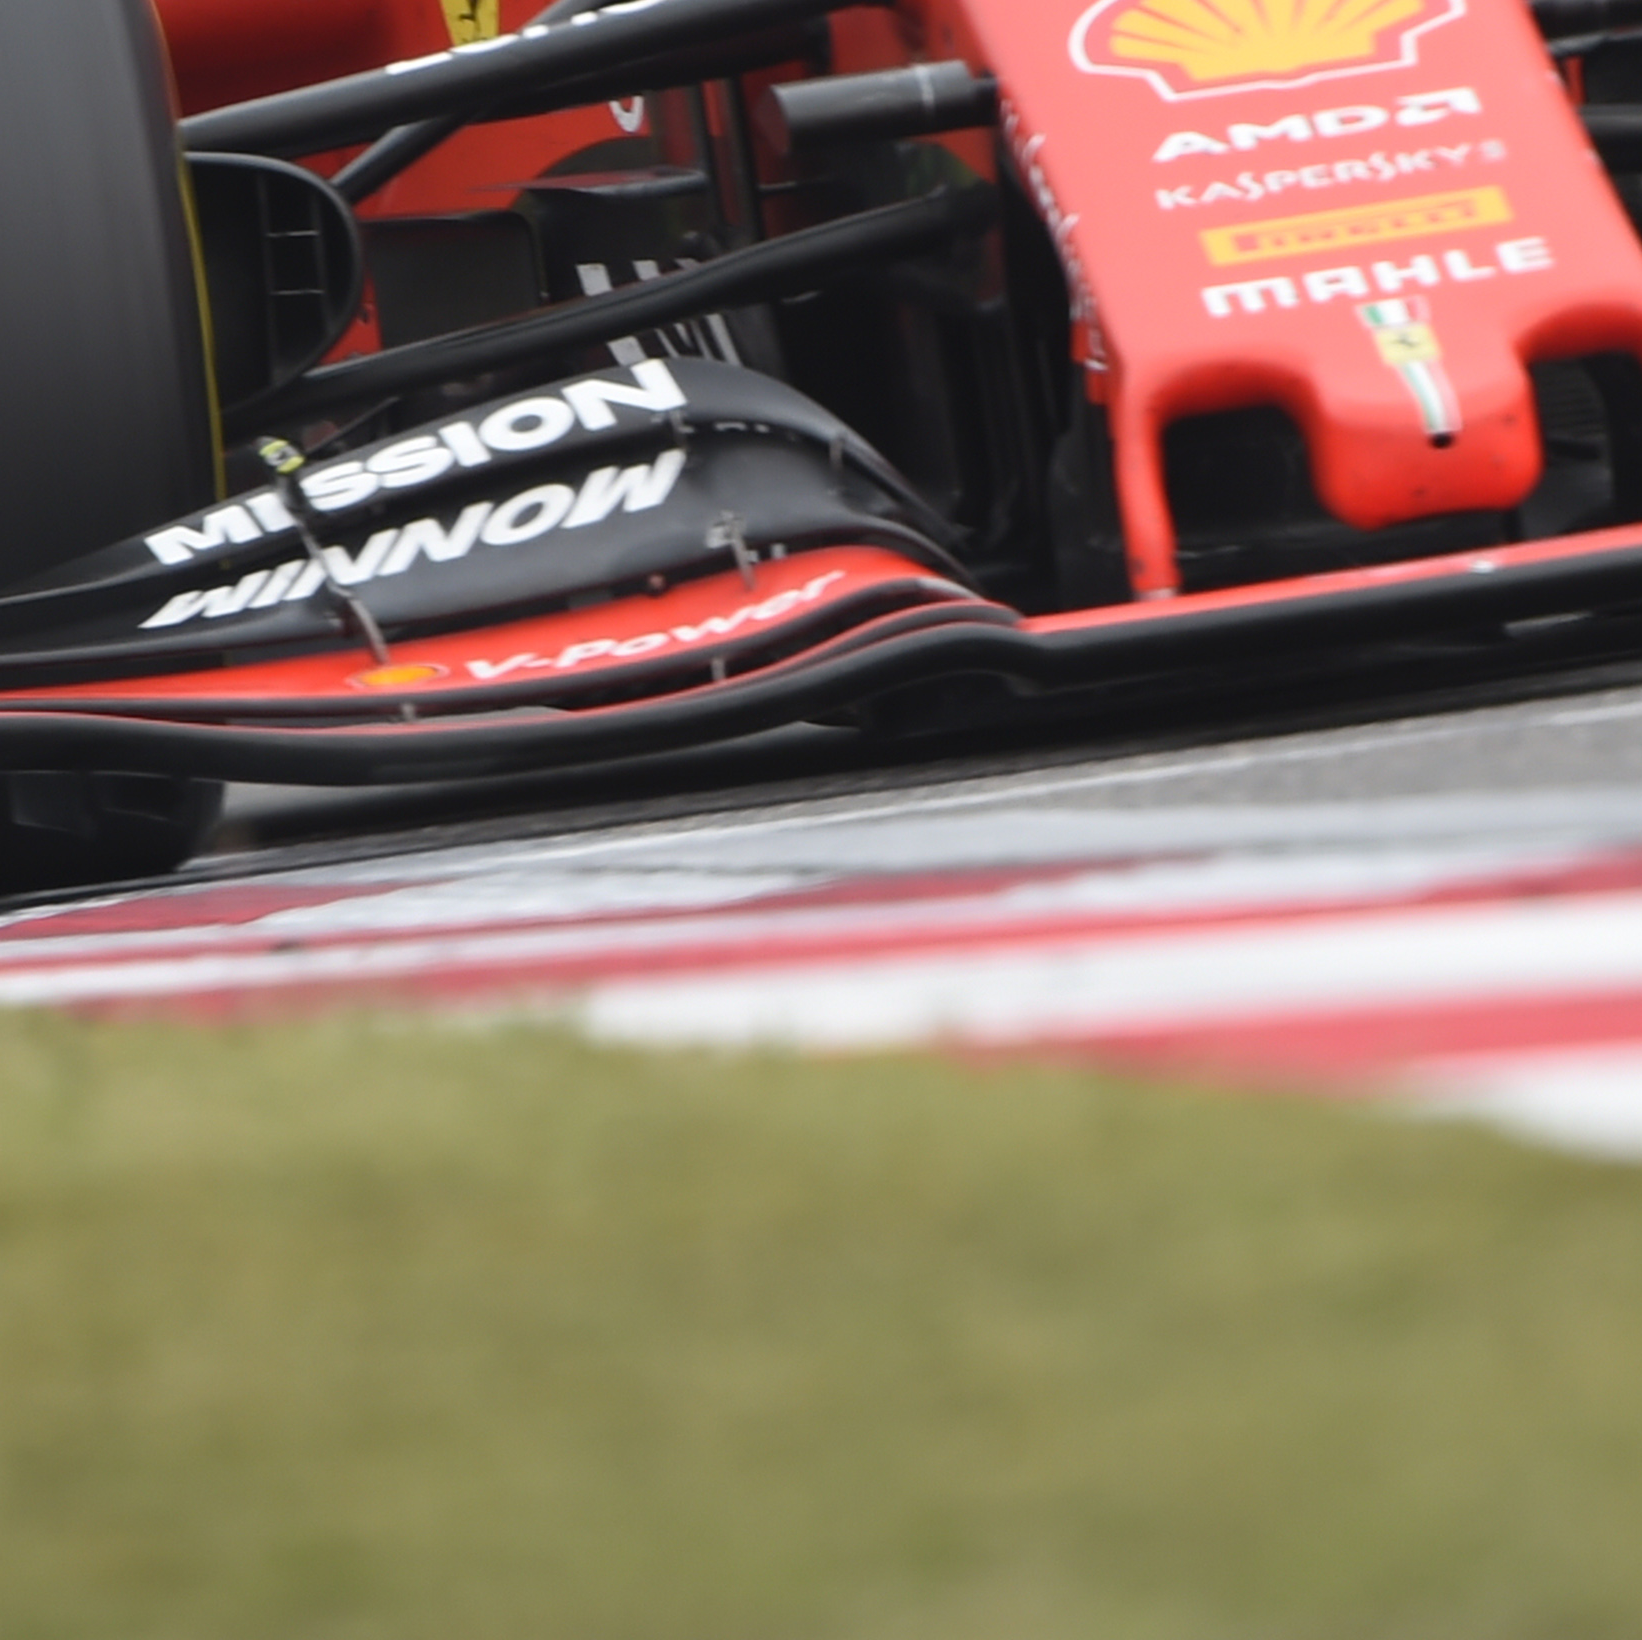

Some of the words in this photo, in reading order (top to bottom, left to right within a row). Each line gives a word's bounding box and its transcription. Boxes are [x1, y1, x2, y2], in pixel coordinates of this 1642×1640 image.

[1153, 105, 1390, 163] AMD
[1154, 143, 1472, 210] KASPERSKY
[1200, 236, 1556, 317] MAHLE
[142, 359, 689, 565] MISSION
[139, 448, 688, 629] WINNOW
[465, 570, 848, 678] V-Power
